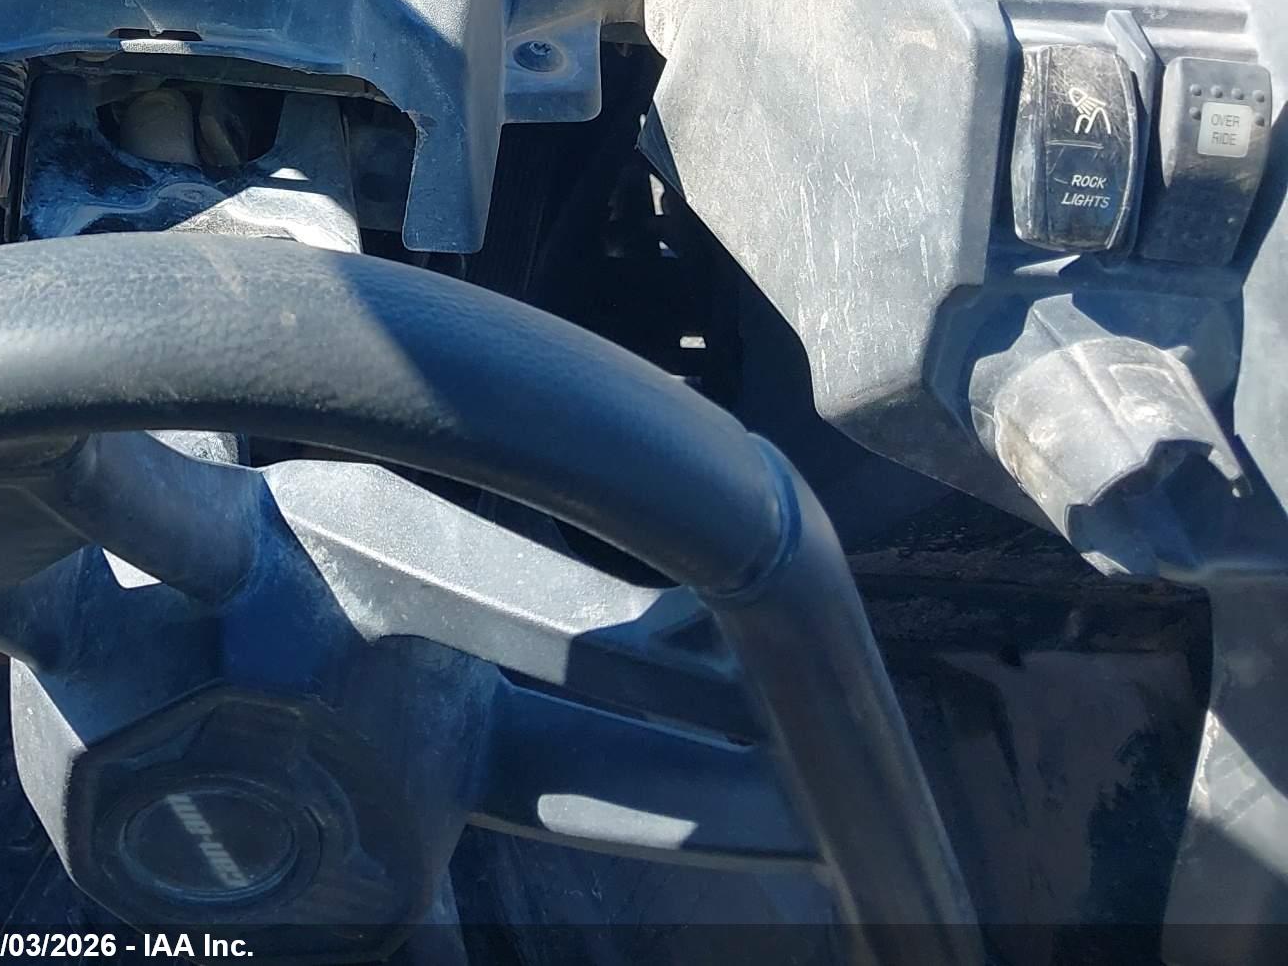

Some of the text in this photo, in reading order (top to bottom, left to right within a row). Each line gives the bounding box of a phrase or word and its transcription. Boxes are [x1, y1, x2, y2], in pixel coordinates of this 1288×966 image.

[1211, 113, 1240, 126] OVER
[1071, 175, 1106, 189] ROCK
[1060, 192, 1110, 209] LIGHTS
